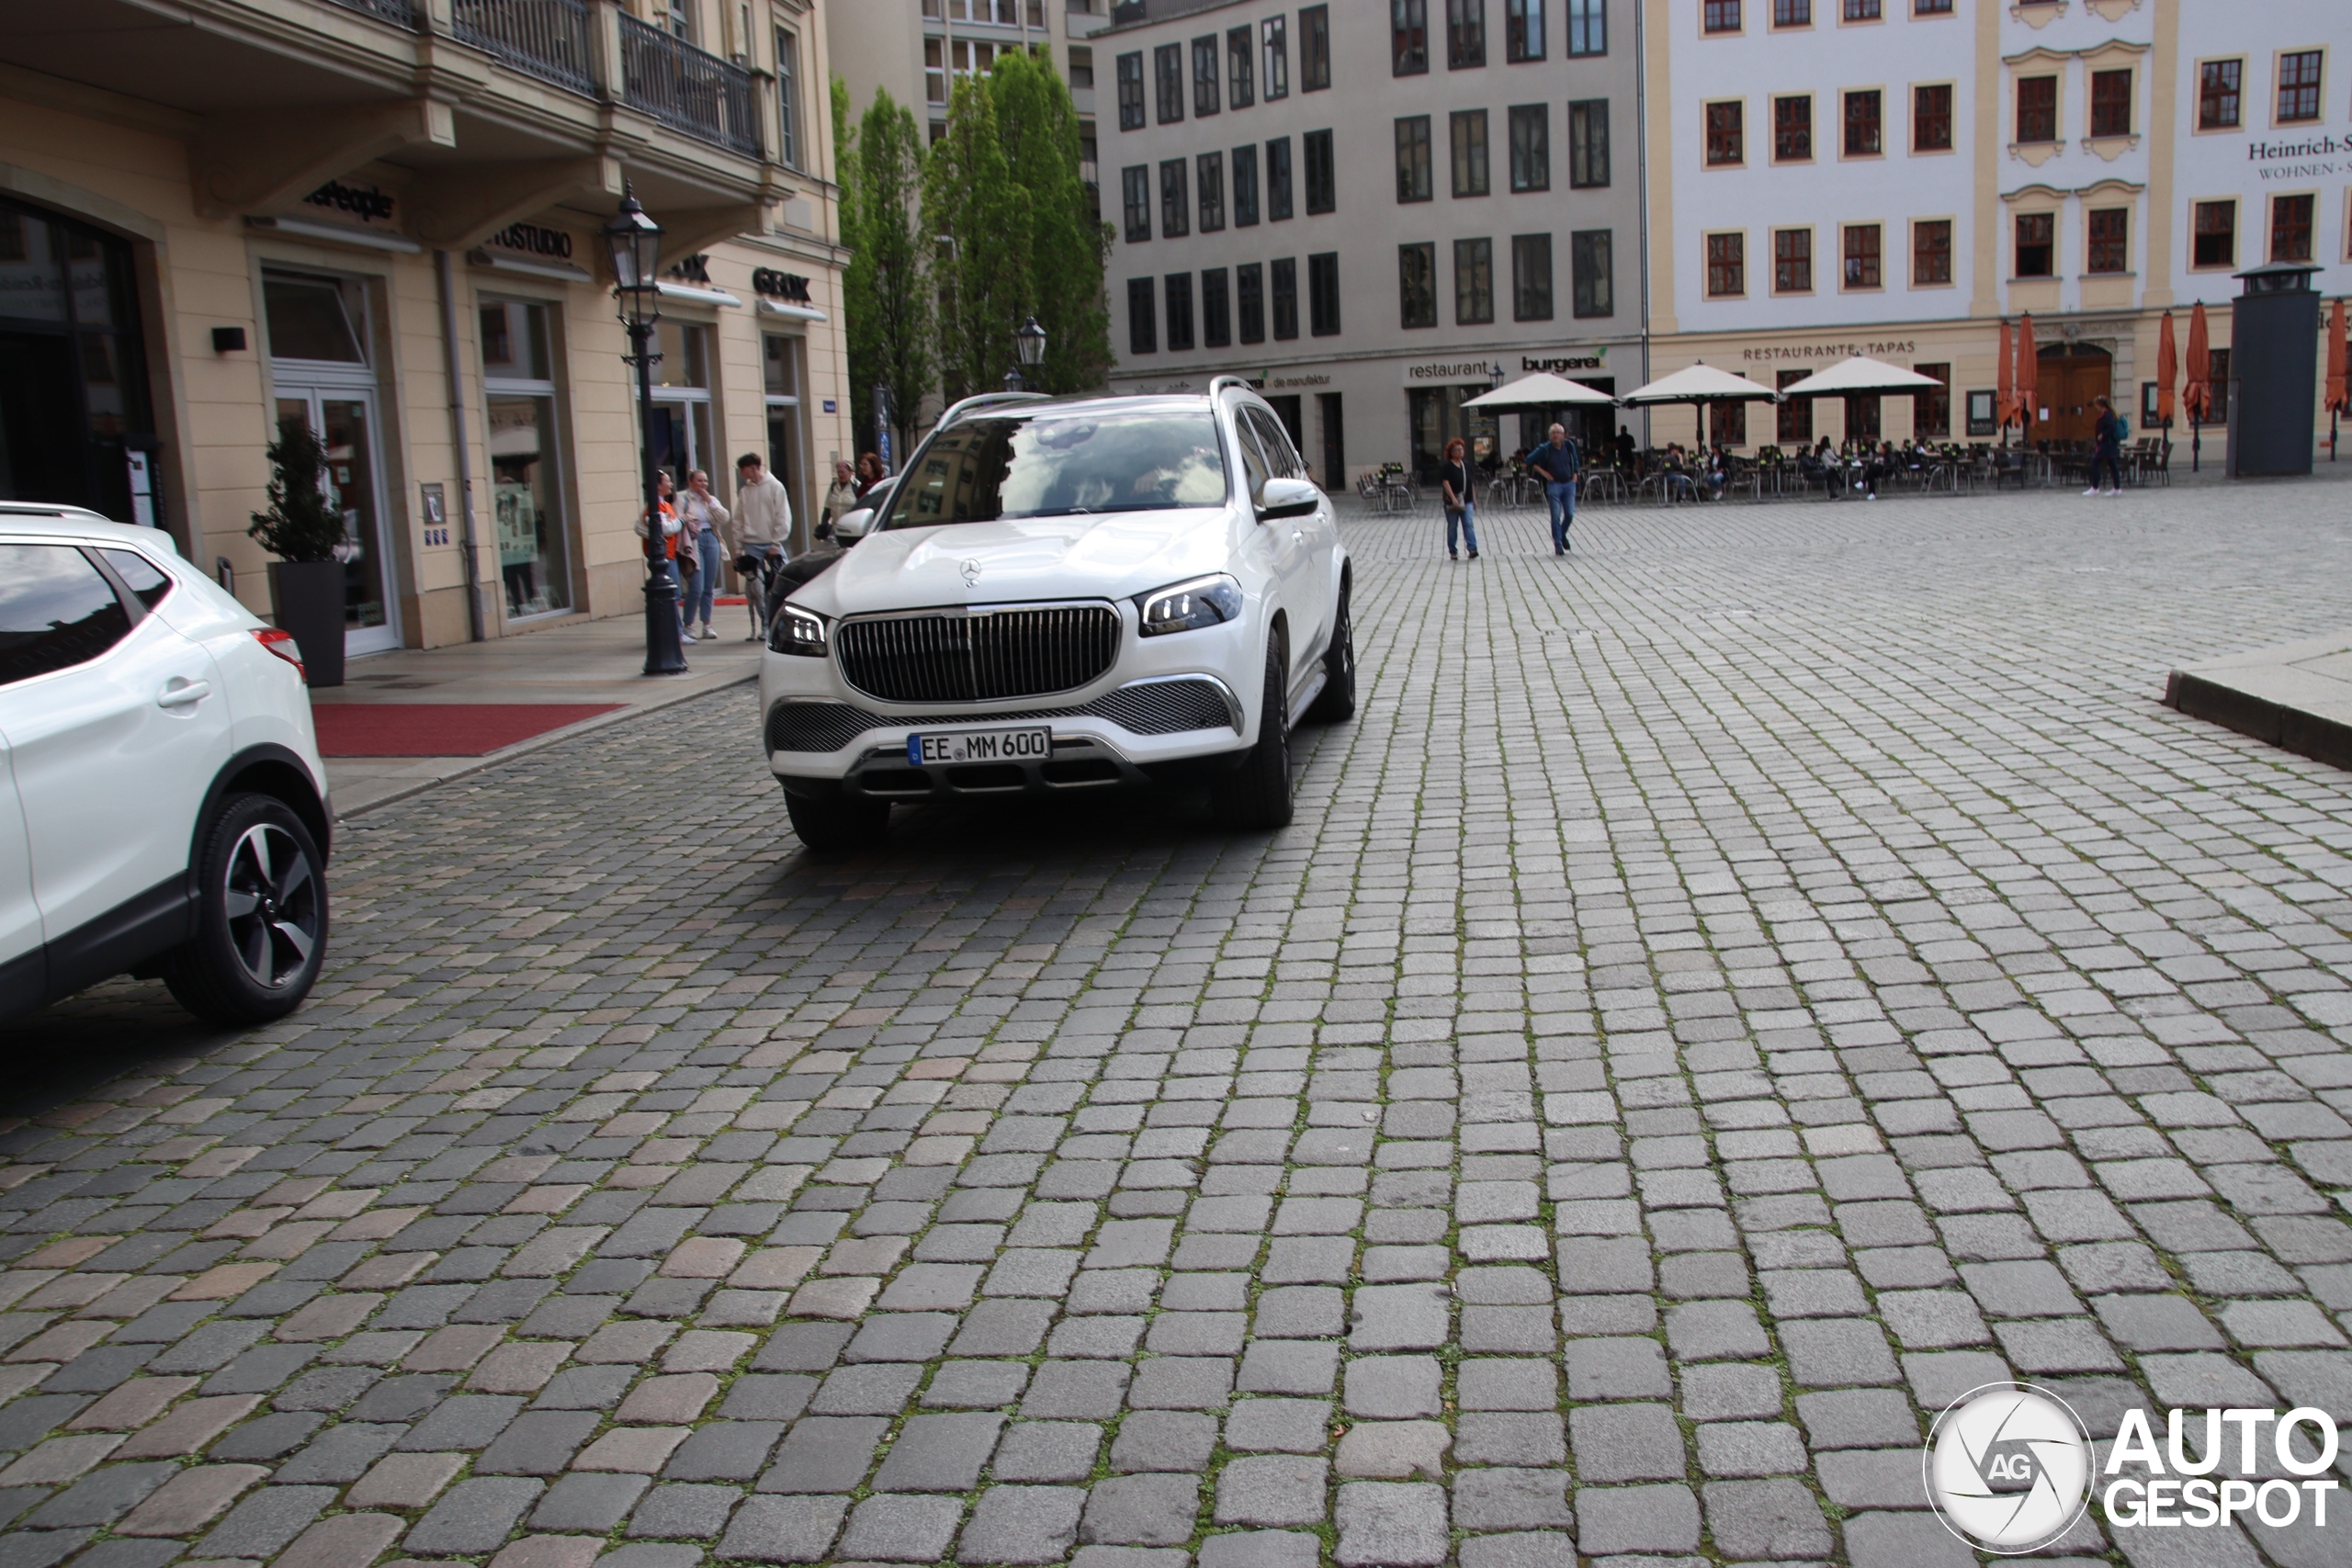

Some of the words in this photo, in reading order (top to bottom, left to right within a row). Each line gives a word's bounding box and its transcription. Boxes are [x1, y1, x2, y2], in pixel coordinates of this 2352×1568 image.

[2259, 163, 2334, 180] WOHNEN
[752, 266, 811, 302] GEOX
[1744, 344, 1856, 361] RESTAURANTE
[1867, 341, 1916, 354] TAPAS
[1409, 359, 1488, 378] restaurant
[1521, 355, 1600, 373] burgerei
[1273, 378, 1285, 388] die
[1286, 374, 1330, 387] manufaktur
[922, 738, 952, 761] EE
[967, 735, 997, 759] MM
[1002, 732, 1045, 757] 600
